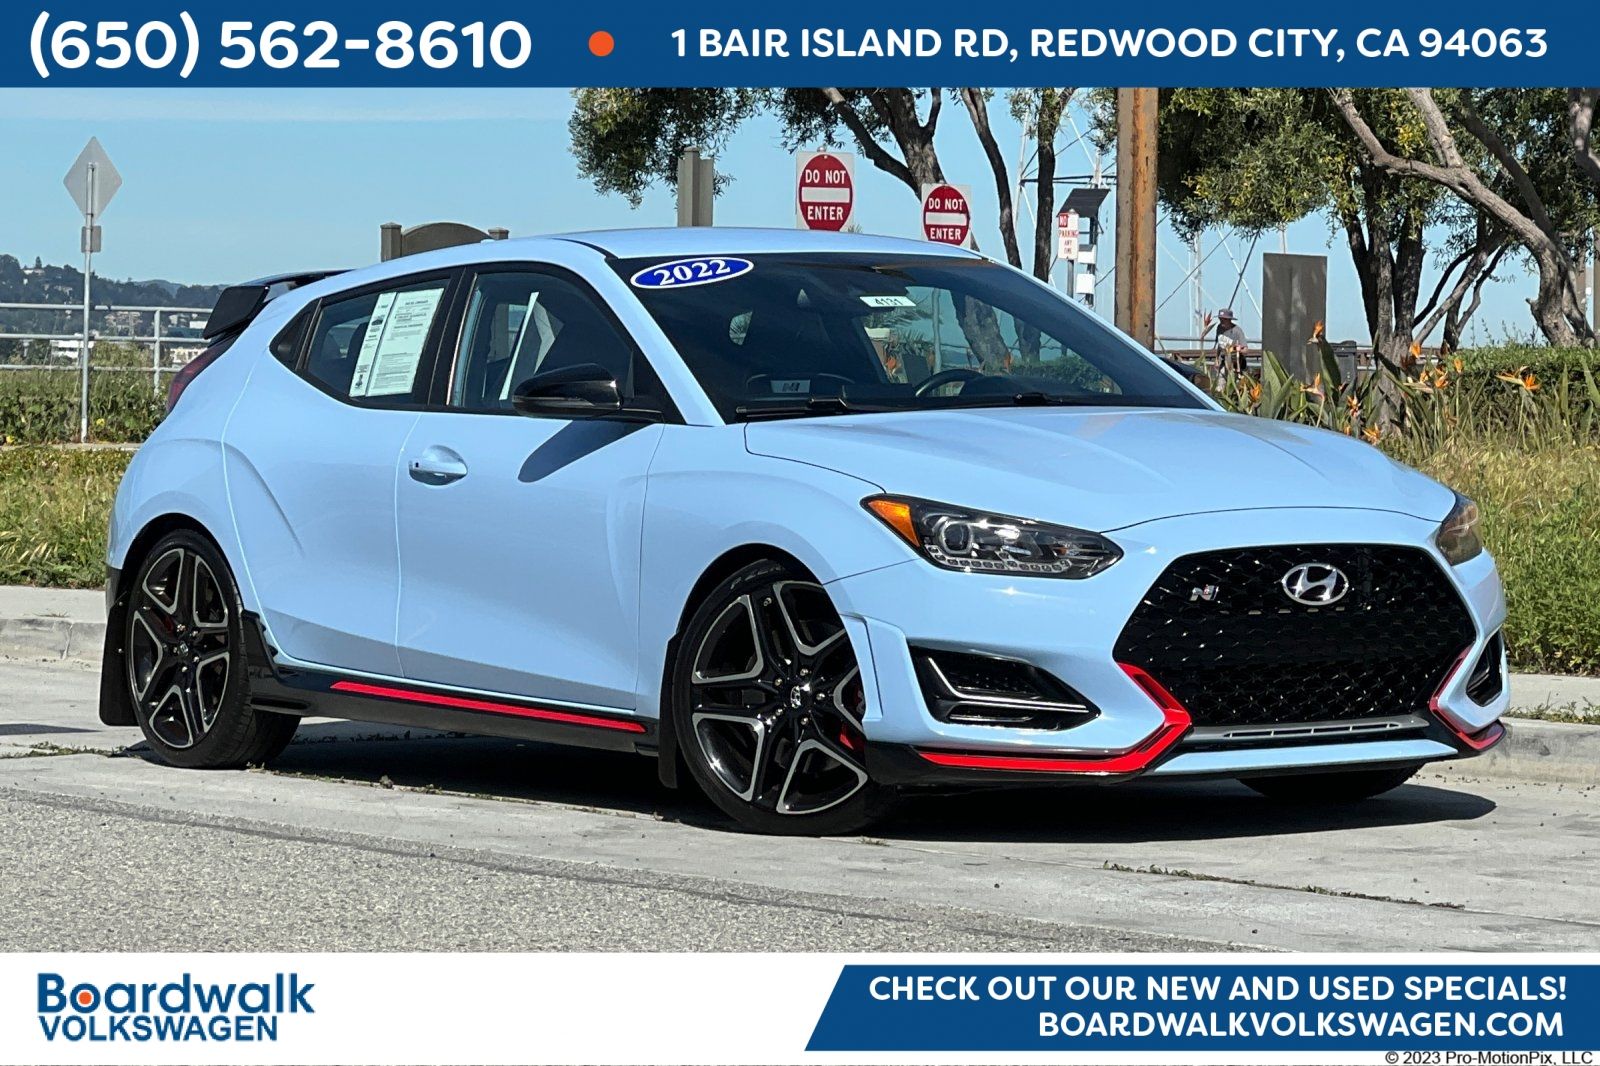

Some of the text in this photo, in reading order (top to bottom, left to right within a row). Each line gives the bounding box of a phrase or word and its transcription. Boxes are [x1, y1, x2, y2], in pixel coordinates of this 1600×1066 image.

[805, 169, 846, 185] DO NOT
[928, 197, 964, 211] DO NOT
[807, 206, 844, 221] ENTER
[930, 227, 962, 240] ENTER
[653, 259, 731, 286] 2022
